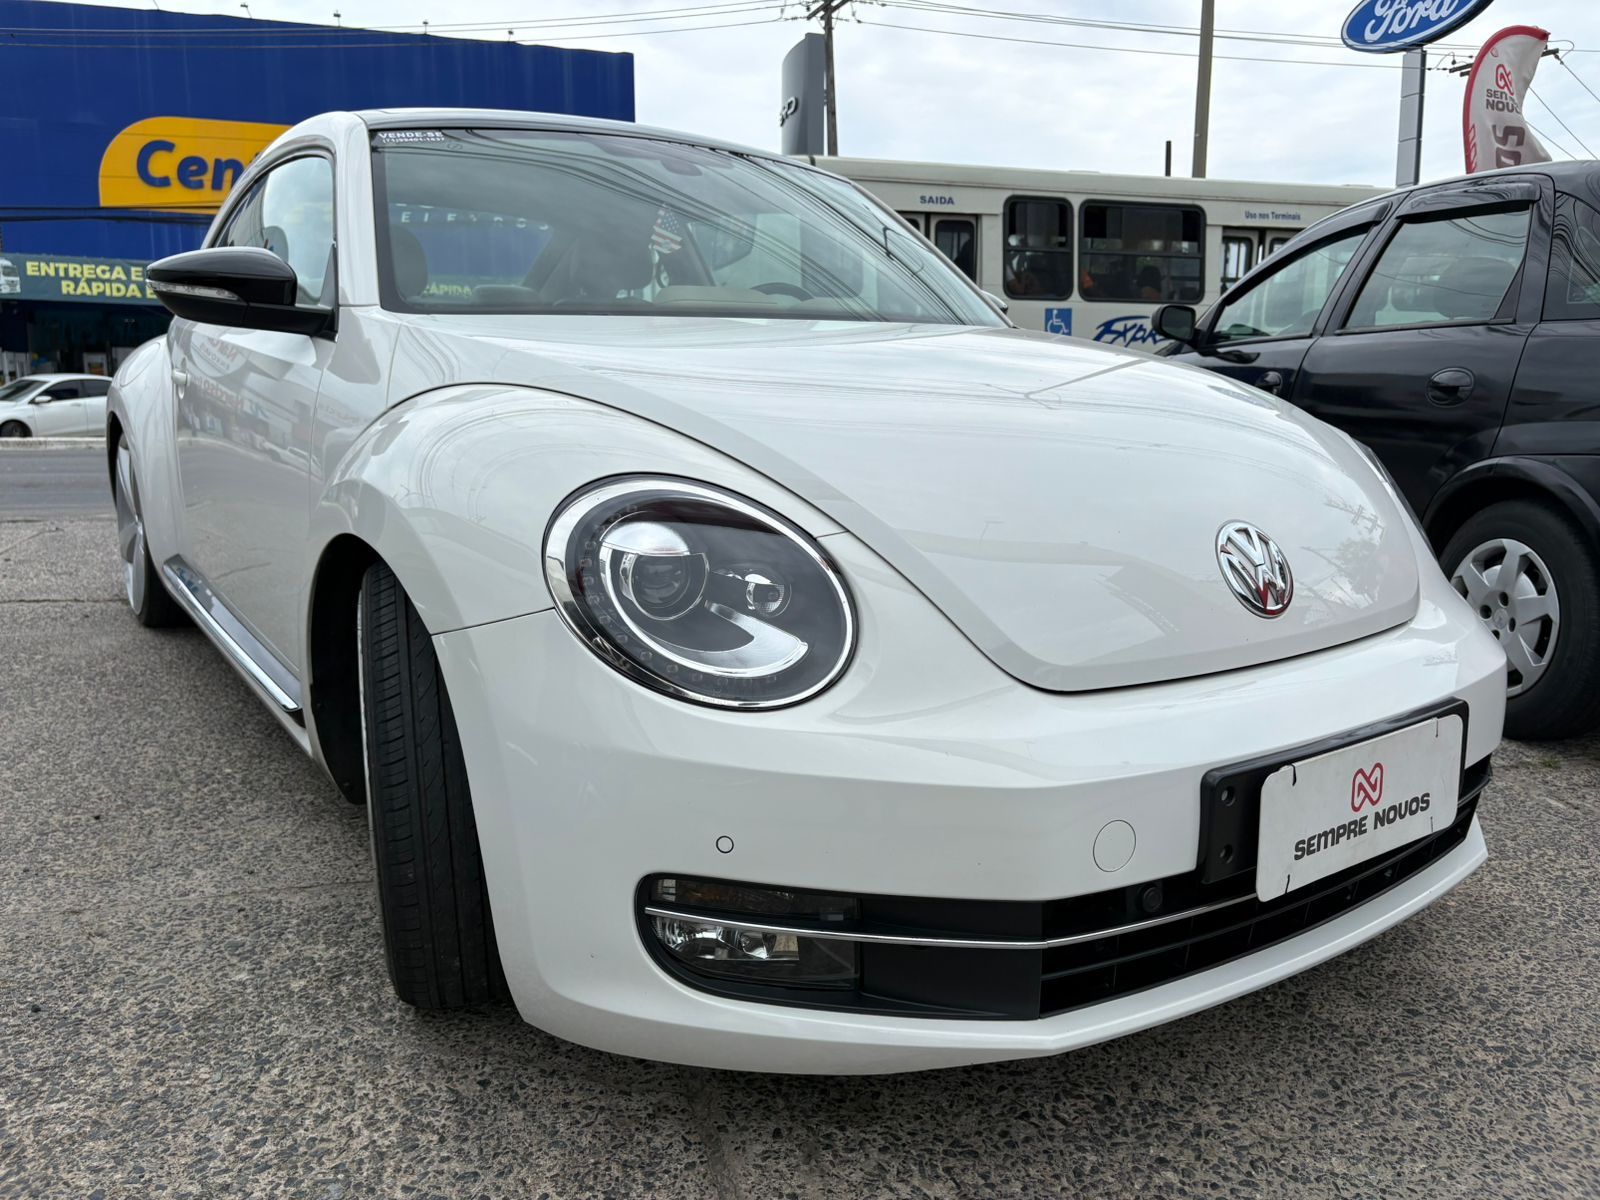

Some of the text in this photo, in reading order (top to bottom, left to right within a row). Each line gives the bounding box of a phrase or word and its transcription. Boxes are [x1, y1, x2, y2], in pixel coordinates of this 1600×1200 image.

[136, 140, 260, 190] Cen
[919, 195, 955, 205] SAIDA
[26, 261, 127, 280] ENTREGA
[61, 277, 142, 298] RÁPIDA
[1294, 815, 1368, 860] SEMPRE
